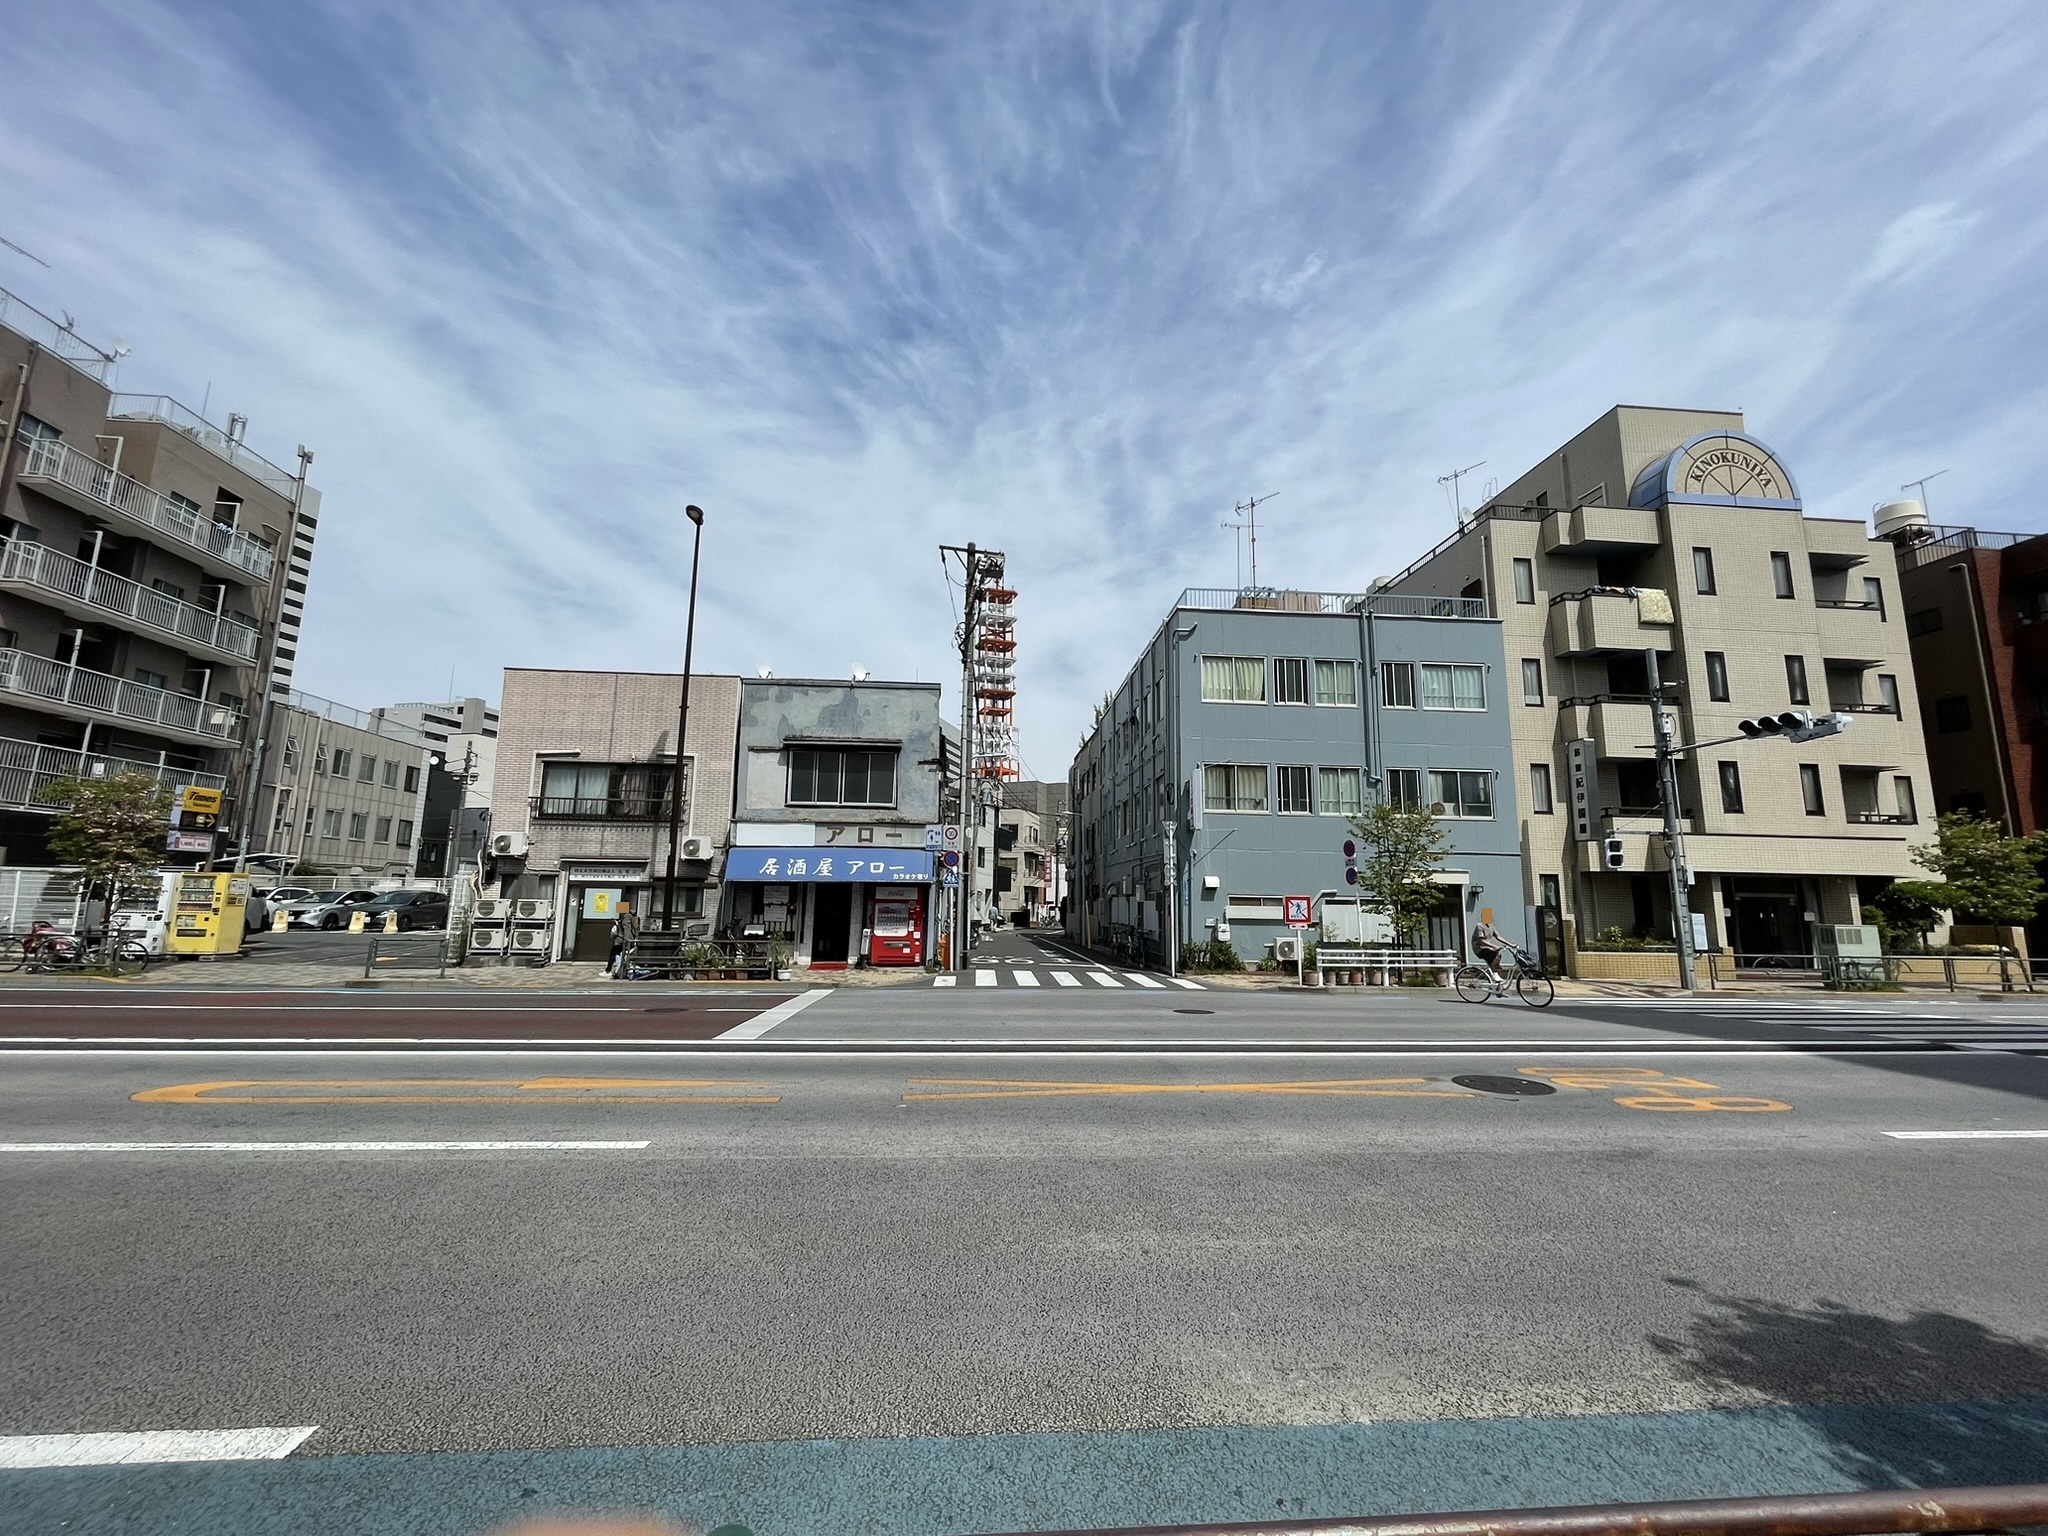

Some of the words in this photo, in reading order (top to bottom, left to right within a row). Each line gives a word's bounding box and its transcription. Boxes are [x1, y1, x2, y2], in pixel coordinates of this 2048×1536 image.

[1690, 451, 1773, 489] KINOKUNIYA
[188, 791, 219, 803] Times
[826, 826, 903, 843] アロー
[759, 857, 834, 877] 居酒屋
[846, 859, 905, 875] アロー
